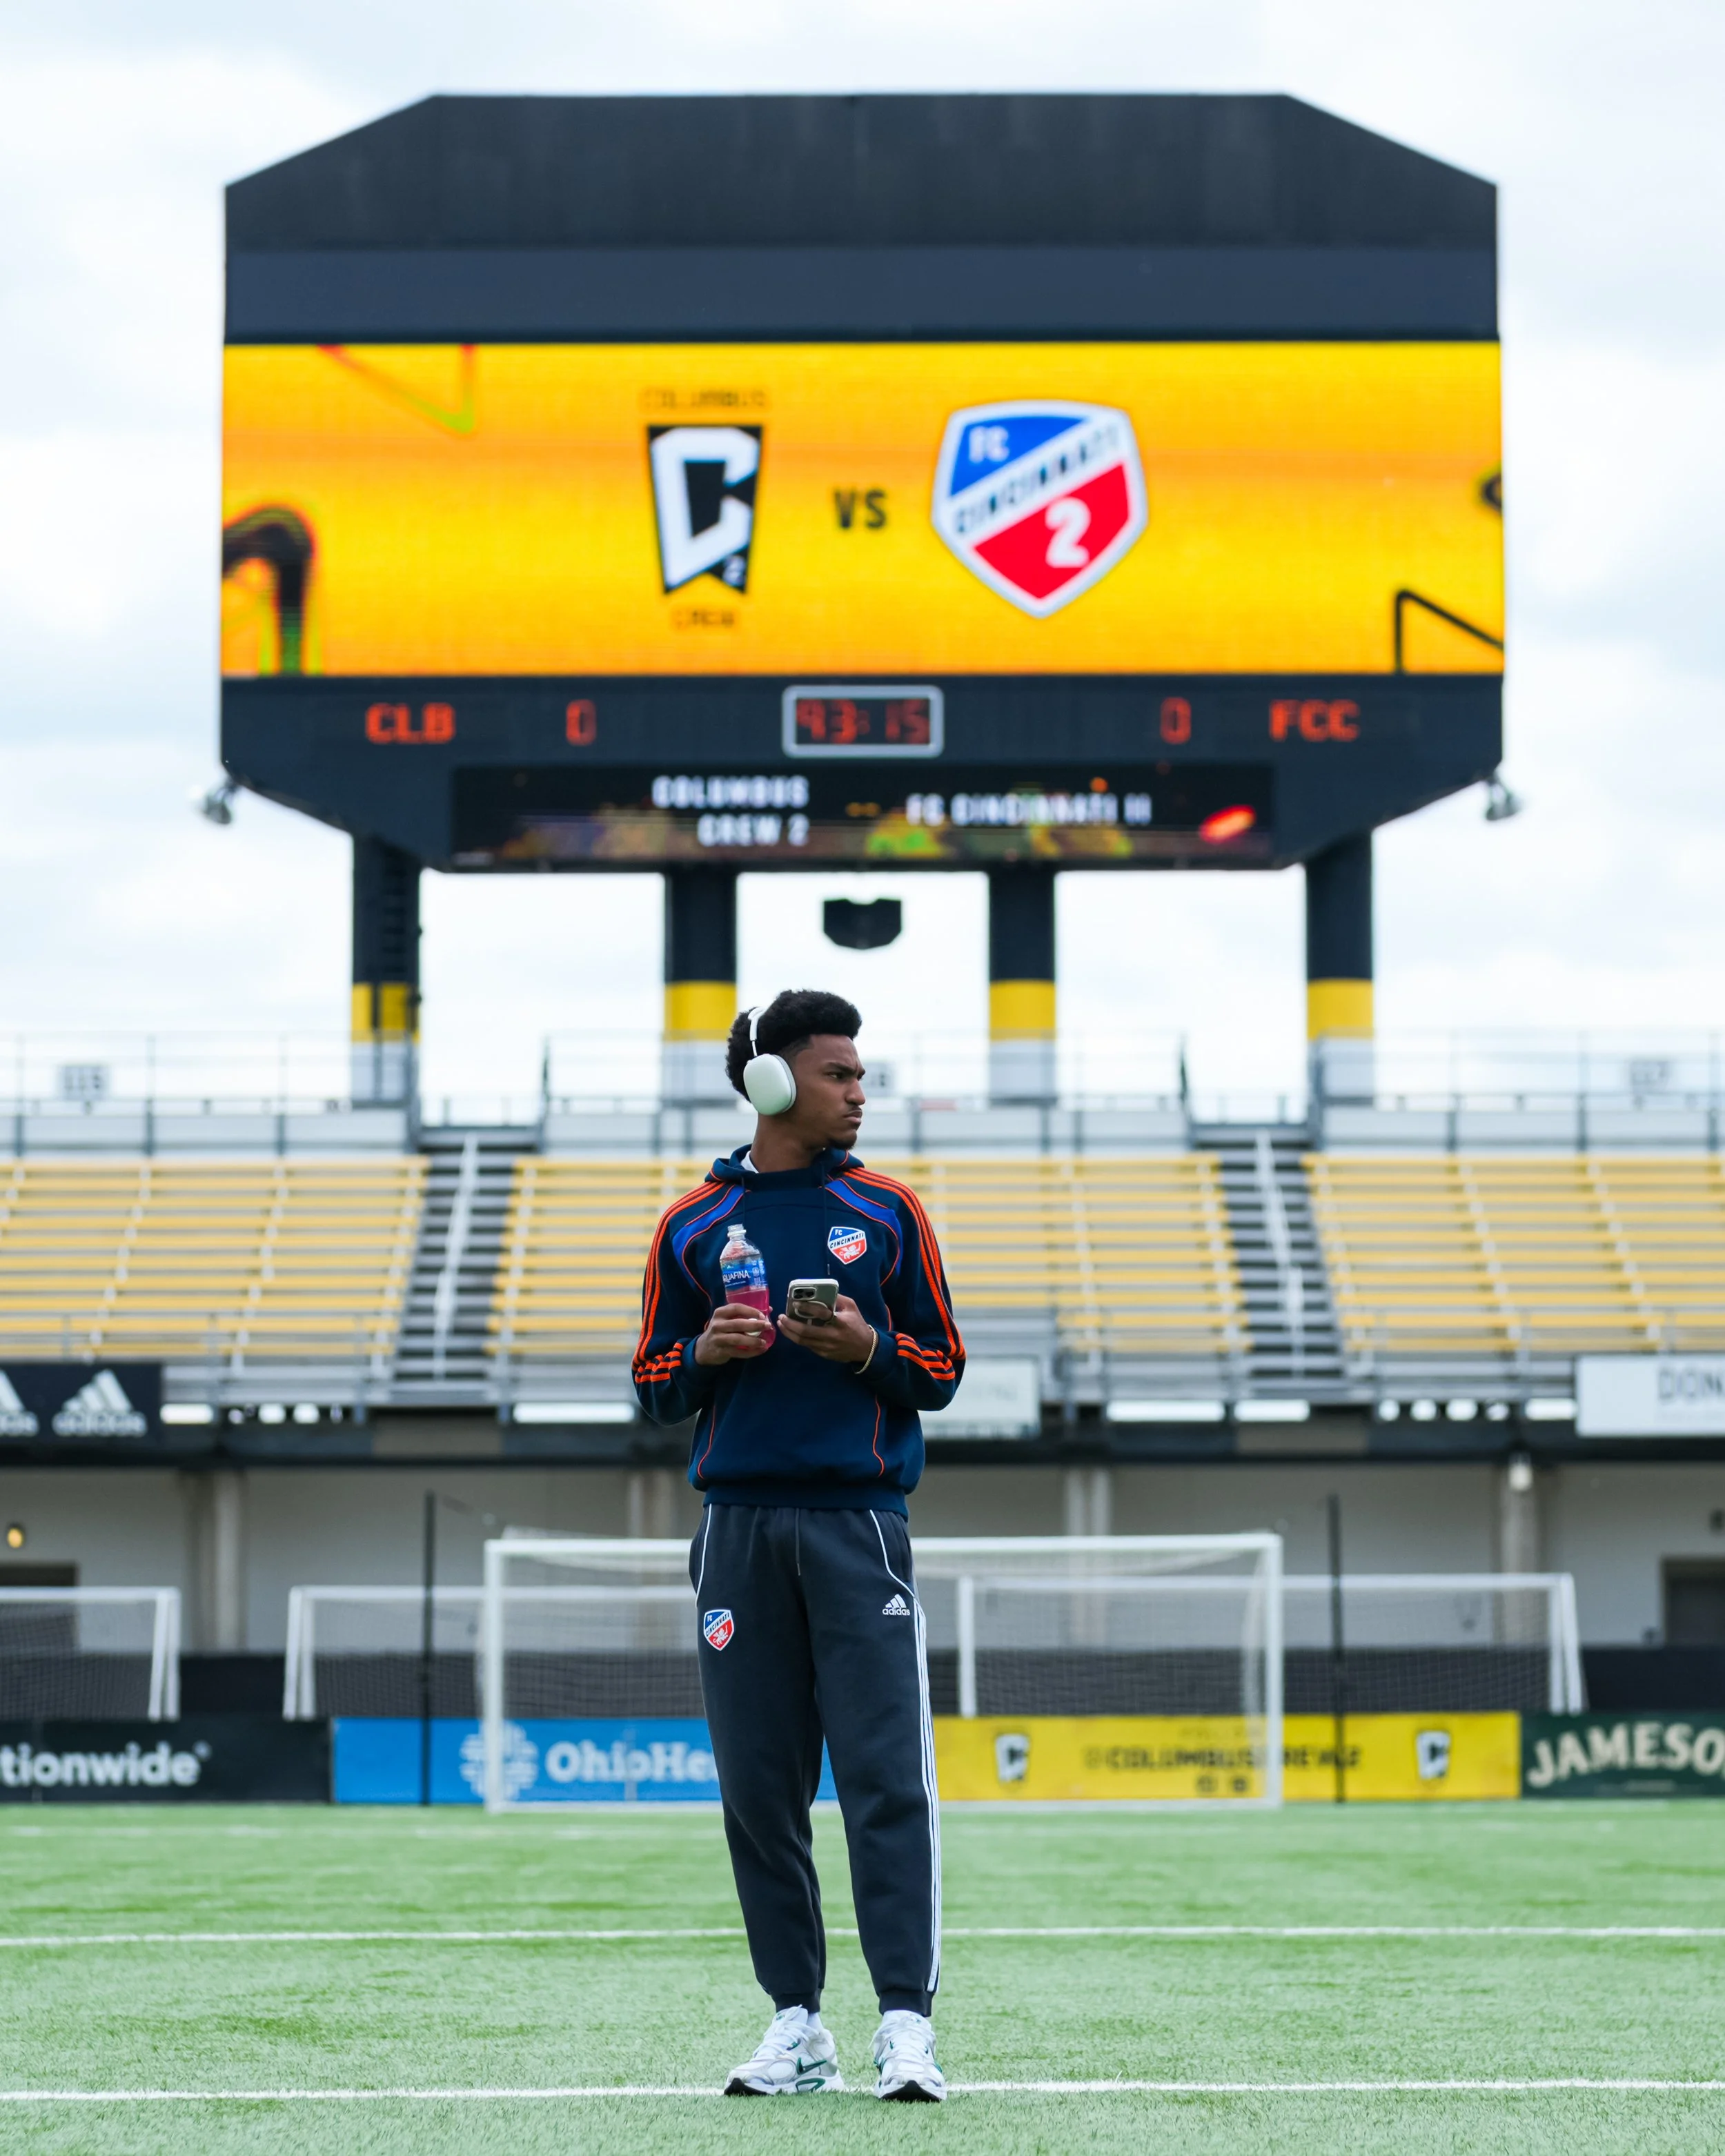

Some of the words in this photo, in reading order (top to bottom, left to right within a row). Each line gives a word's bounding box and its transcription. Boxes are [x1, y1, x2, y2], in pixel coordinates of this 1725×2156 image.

[834, 488, 887, 528] VS
[1045, 497, 1092, 568] 2
[366, 702, 456, 744] CLB
[1269, 699, 1360, 742] FCC
[652, 775, 810, 809] COLUMBUS
[906, 793, 944, 826] FC
[950, 793, 1118, 826] CINCINNATI
[697, 813, 782, 847] CREW
[787, 813, 810, 847] 2
[829, 1232, 864, 1249] CINCINNATI
[705, 1612, 729, 1637] CINCINNATI
[882, 1607, 910, 1616] adidas
